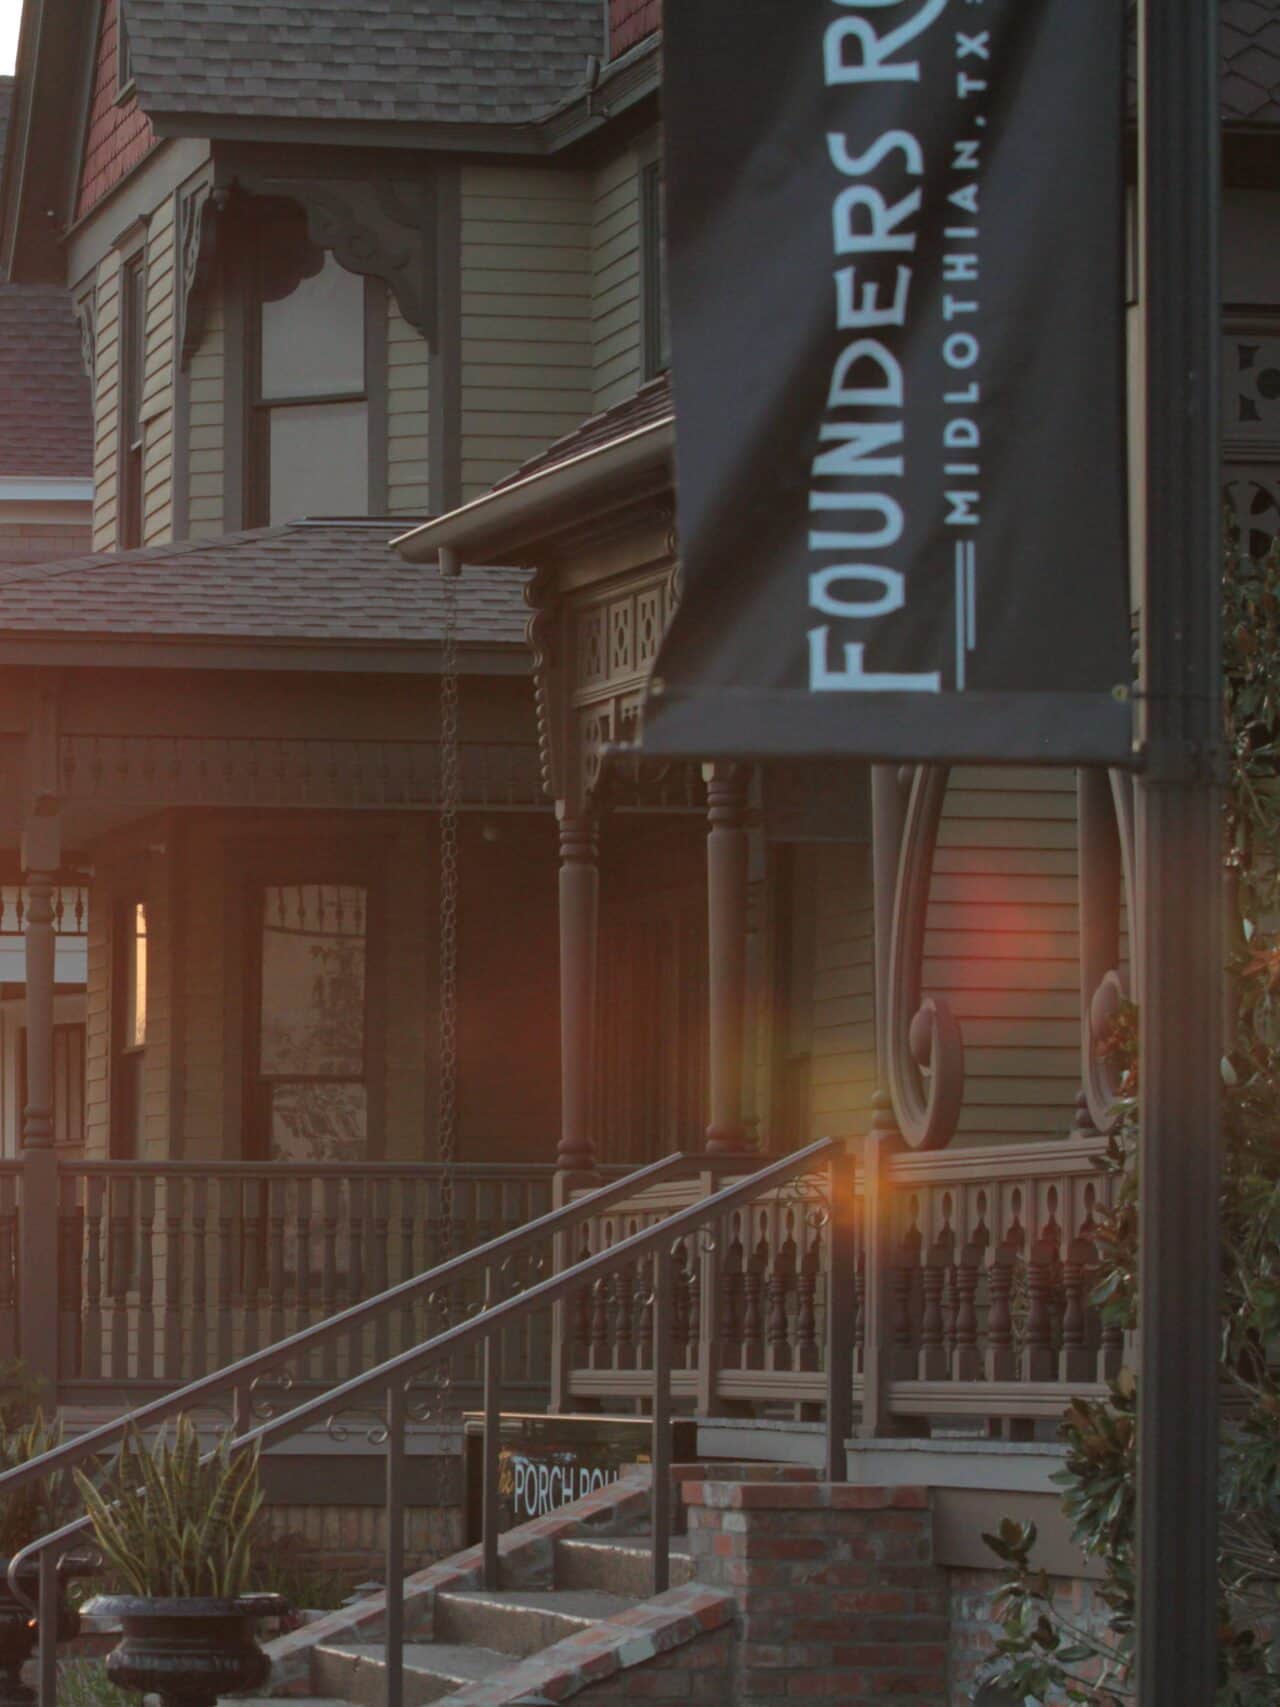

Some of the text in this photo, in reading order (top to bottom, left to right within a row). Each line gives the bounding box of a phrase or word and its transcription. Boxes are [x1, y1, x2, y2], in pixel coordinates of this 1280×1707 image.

[955, 30, 990, 98] TX
[807, 0, 948, 694] FOUNDERS R
[514, 1462, 574, 1516] PORCH
